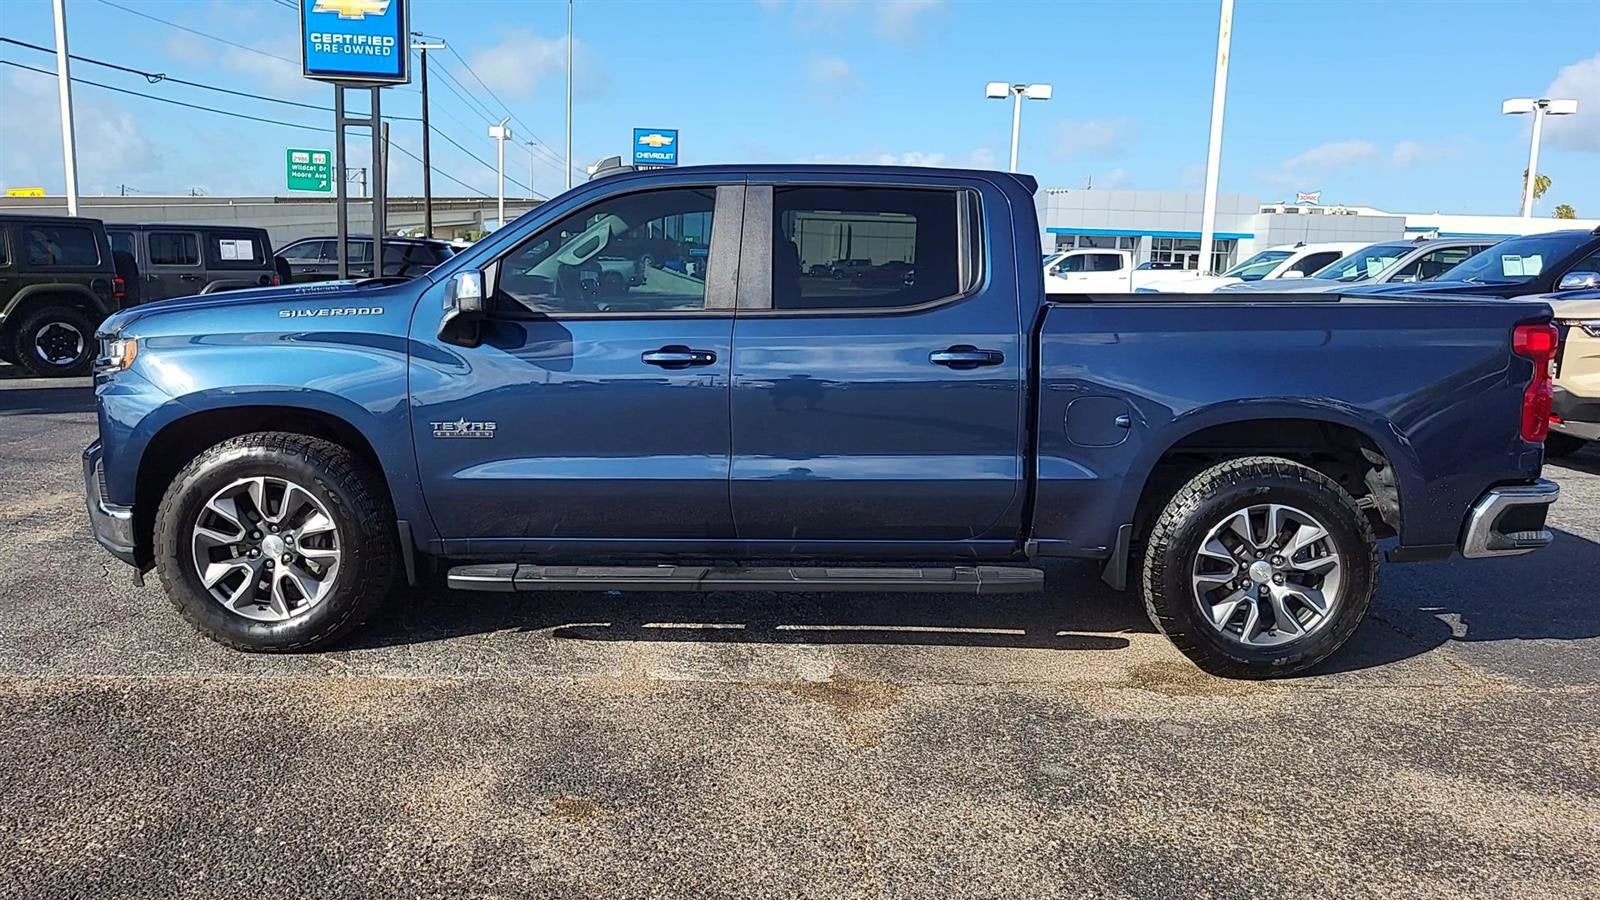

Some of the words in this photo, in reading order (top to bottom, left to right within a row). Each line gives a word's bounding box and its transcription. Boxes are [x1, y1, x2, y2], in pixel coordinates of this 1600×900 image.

[310, 32, 395, 47] CERTIFIED
[314, 43, 391, 56] PRE-OWNED
[636, 151, 674, 160] CHEVROLET
[279, 307, 384, 318] SILVERADO
[430, 417, 497, 432] TEXAS
